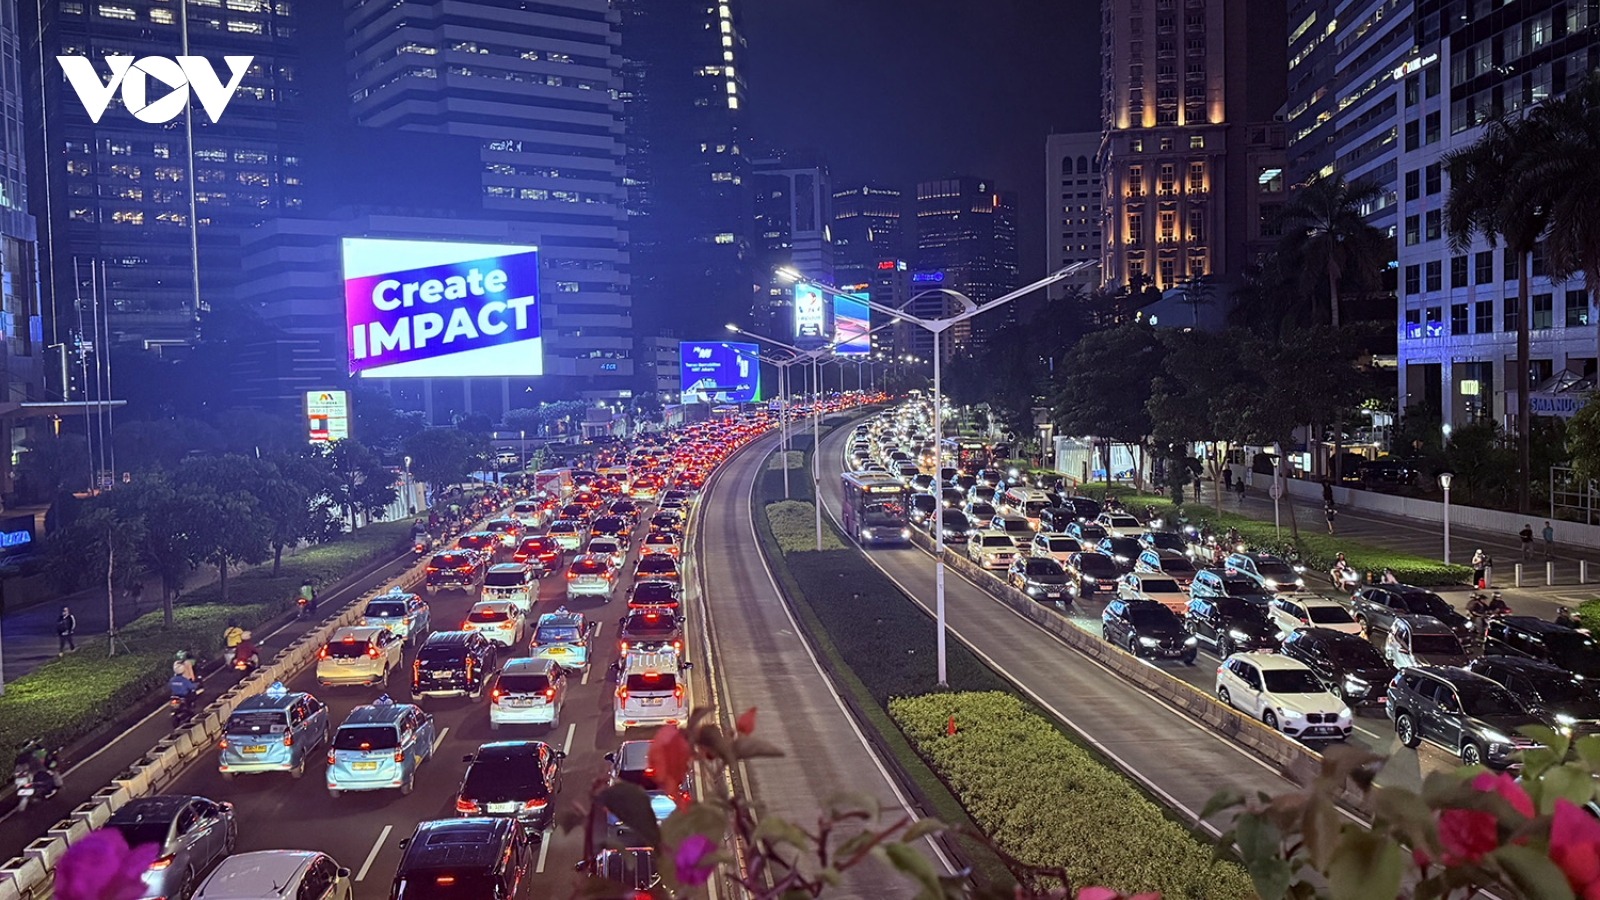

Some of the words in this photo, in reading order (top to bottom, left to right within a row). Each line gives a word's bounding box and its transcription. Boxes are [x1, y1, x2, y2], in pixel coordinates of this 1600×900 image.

[878, 261, 894, 270] ABB
[372, 267, 508, 312] Create
[351, 295, 535, 360] IMPACT
